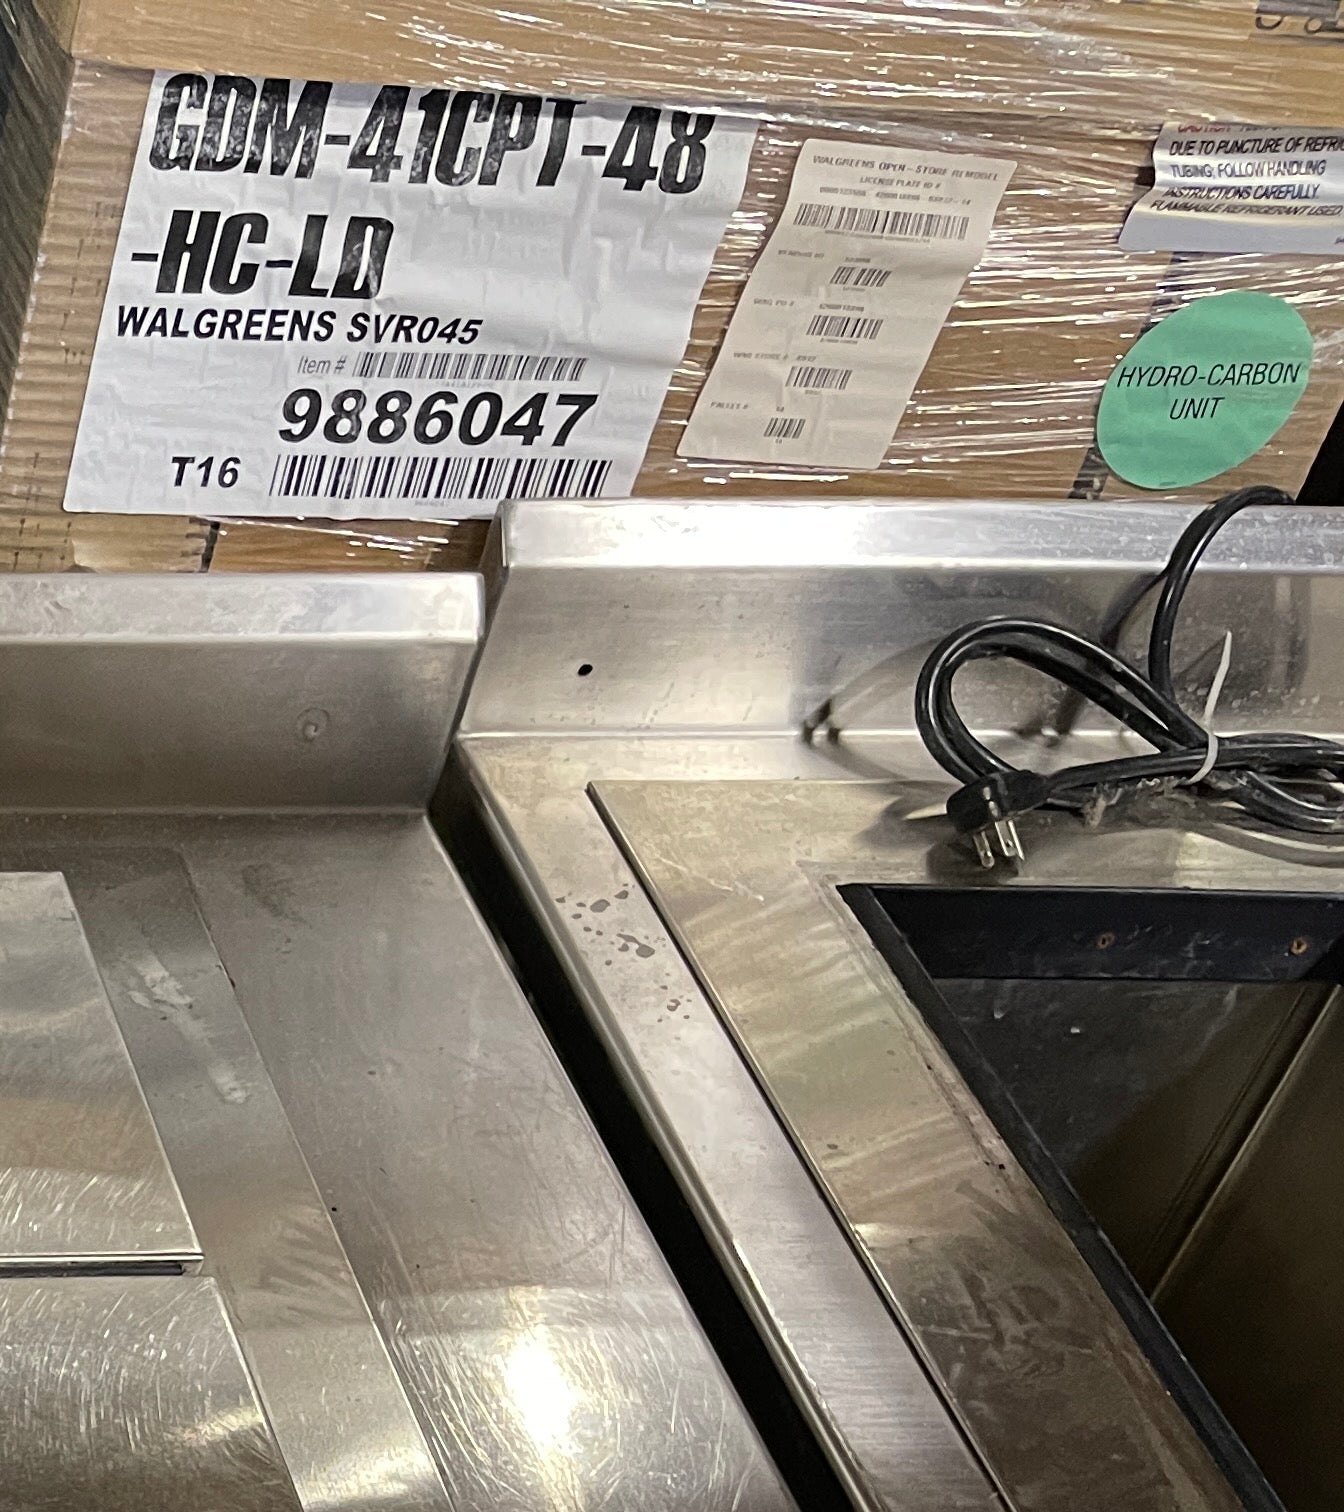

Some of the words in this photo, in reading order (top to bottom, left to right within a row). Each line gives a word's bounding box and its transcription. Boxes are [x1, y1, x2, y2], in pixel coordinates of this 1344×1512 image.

[148, 73, 715, 194] GDM-41CPT-48
[1169, 141, 1197, 156] DUE
[1198, 140, 1216, 155] TO
[1215, 137, 1284, 155] PUNCTURE
[1285, 137, 1304, 152] OF
[813, 155, 875, 169] WALGREENS
[878, 162, 906, 172] OPEN
[915, 165, 948, 177] STORE
[1217, 161, 1264, 177] FOLLOW
[1267, 160, 1327, 177] HANDLING
[1164, 186, 1251, 200] INSTRUCTIONS
[1151, 200, 1221, 213] FLAMMABLE
[1223, 203, 1310, 215] REFRIGERANT
[131, 210, 394, 300] -HC-LD
[116, 305, 337, 343] WALGREENS
[347, 314, 483, 345] SVR045
[297, 356, 330, 374] Item
[334, 357, 346, 373] #
[1117, 362, 1303, 387] HYDRO-CARBON
[278, 388, 599, 447] 9886047
[1169, 397, 1225, 420] UNIT
[171, 455, 240, 489] T16
